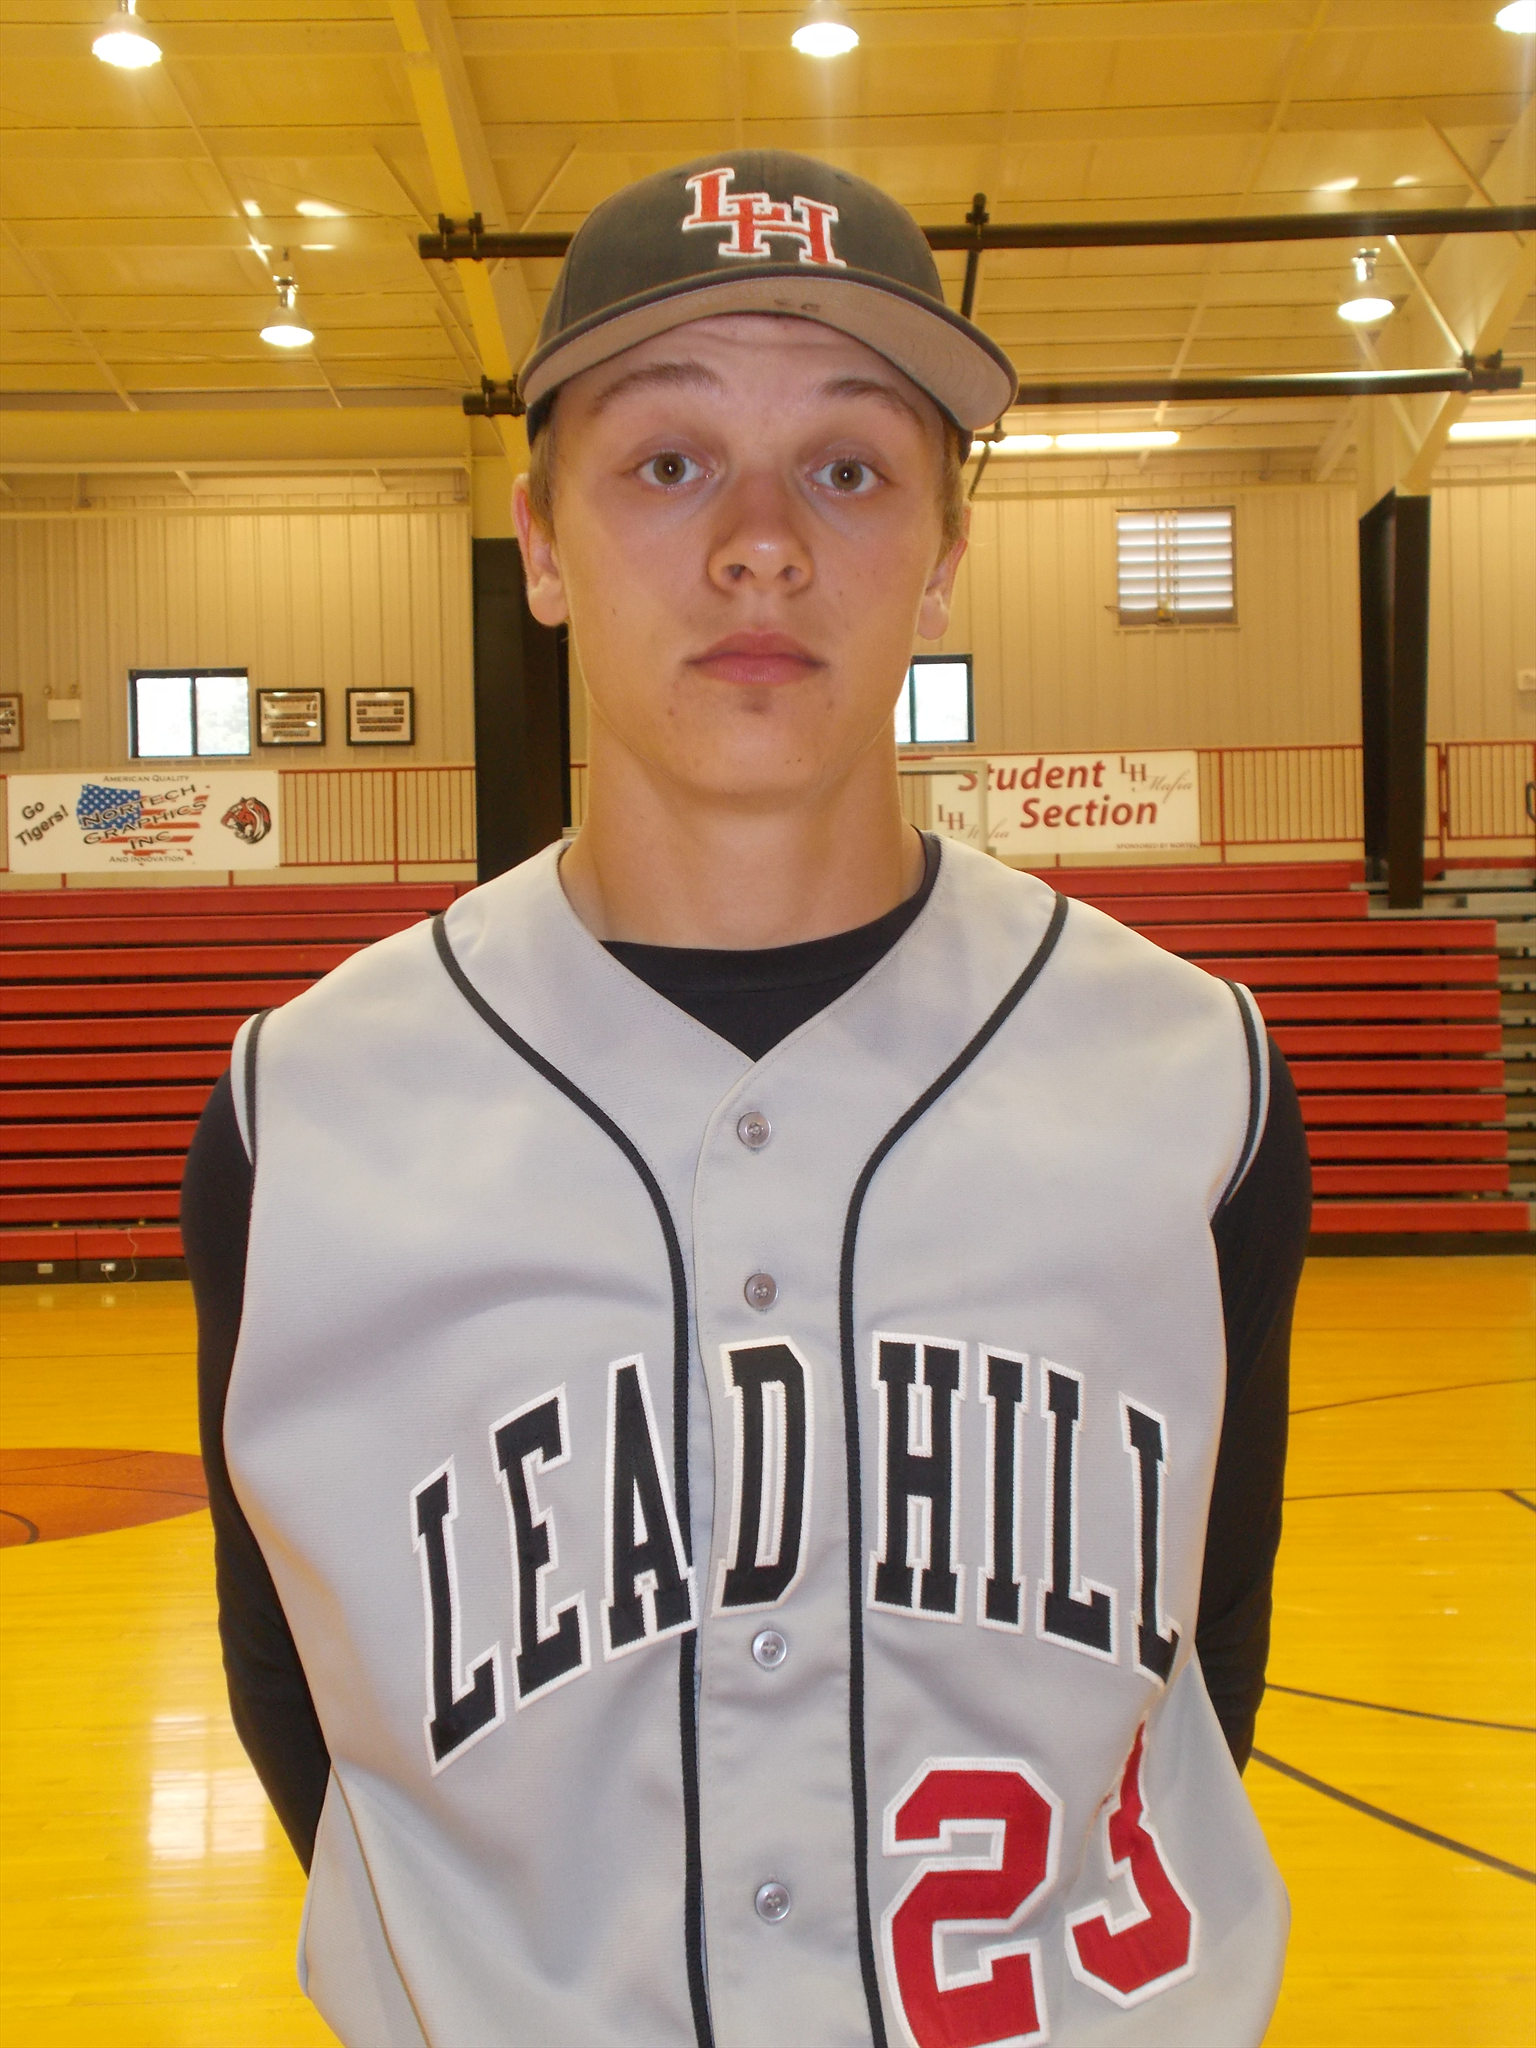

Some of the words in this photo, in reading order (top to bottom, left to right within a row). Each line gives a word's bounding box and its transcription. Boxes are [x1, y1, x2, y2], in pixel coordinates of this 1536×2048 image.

[682, 167, 847, 268] LH
[103, 775, 150, 783] AMERICAN
[152, 774, 190, 782] QUALITY
[1119, 755, 1147, 782] LH
[21, 801, 45, 820] Go
[82, 784, 197, 827] NORTECH
[937, 803, 965, 830] LH
[1020, 794, 1158, 829] Section
[15, 804, 69, 846] Tigers!
[83, 800, 207, 845] GRAPHICS
[129, 830, 171, 850] INC
[130, 855, 185, 863] INNOVATION
[410, 1335, 815, 1777] LEAD
[866, 1330, 1183, 1690] HILL
